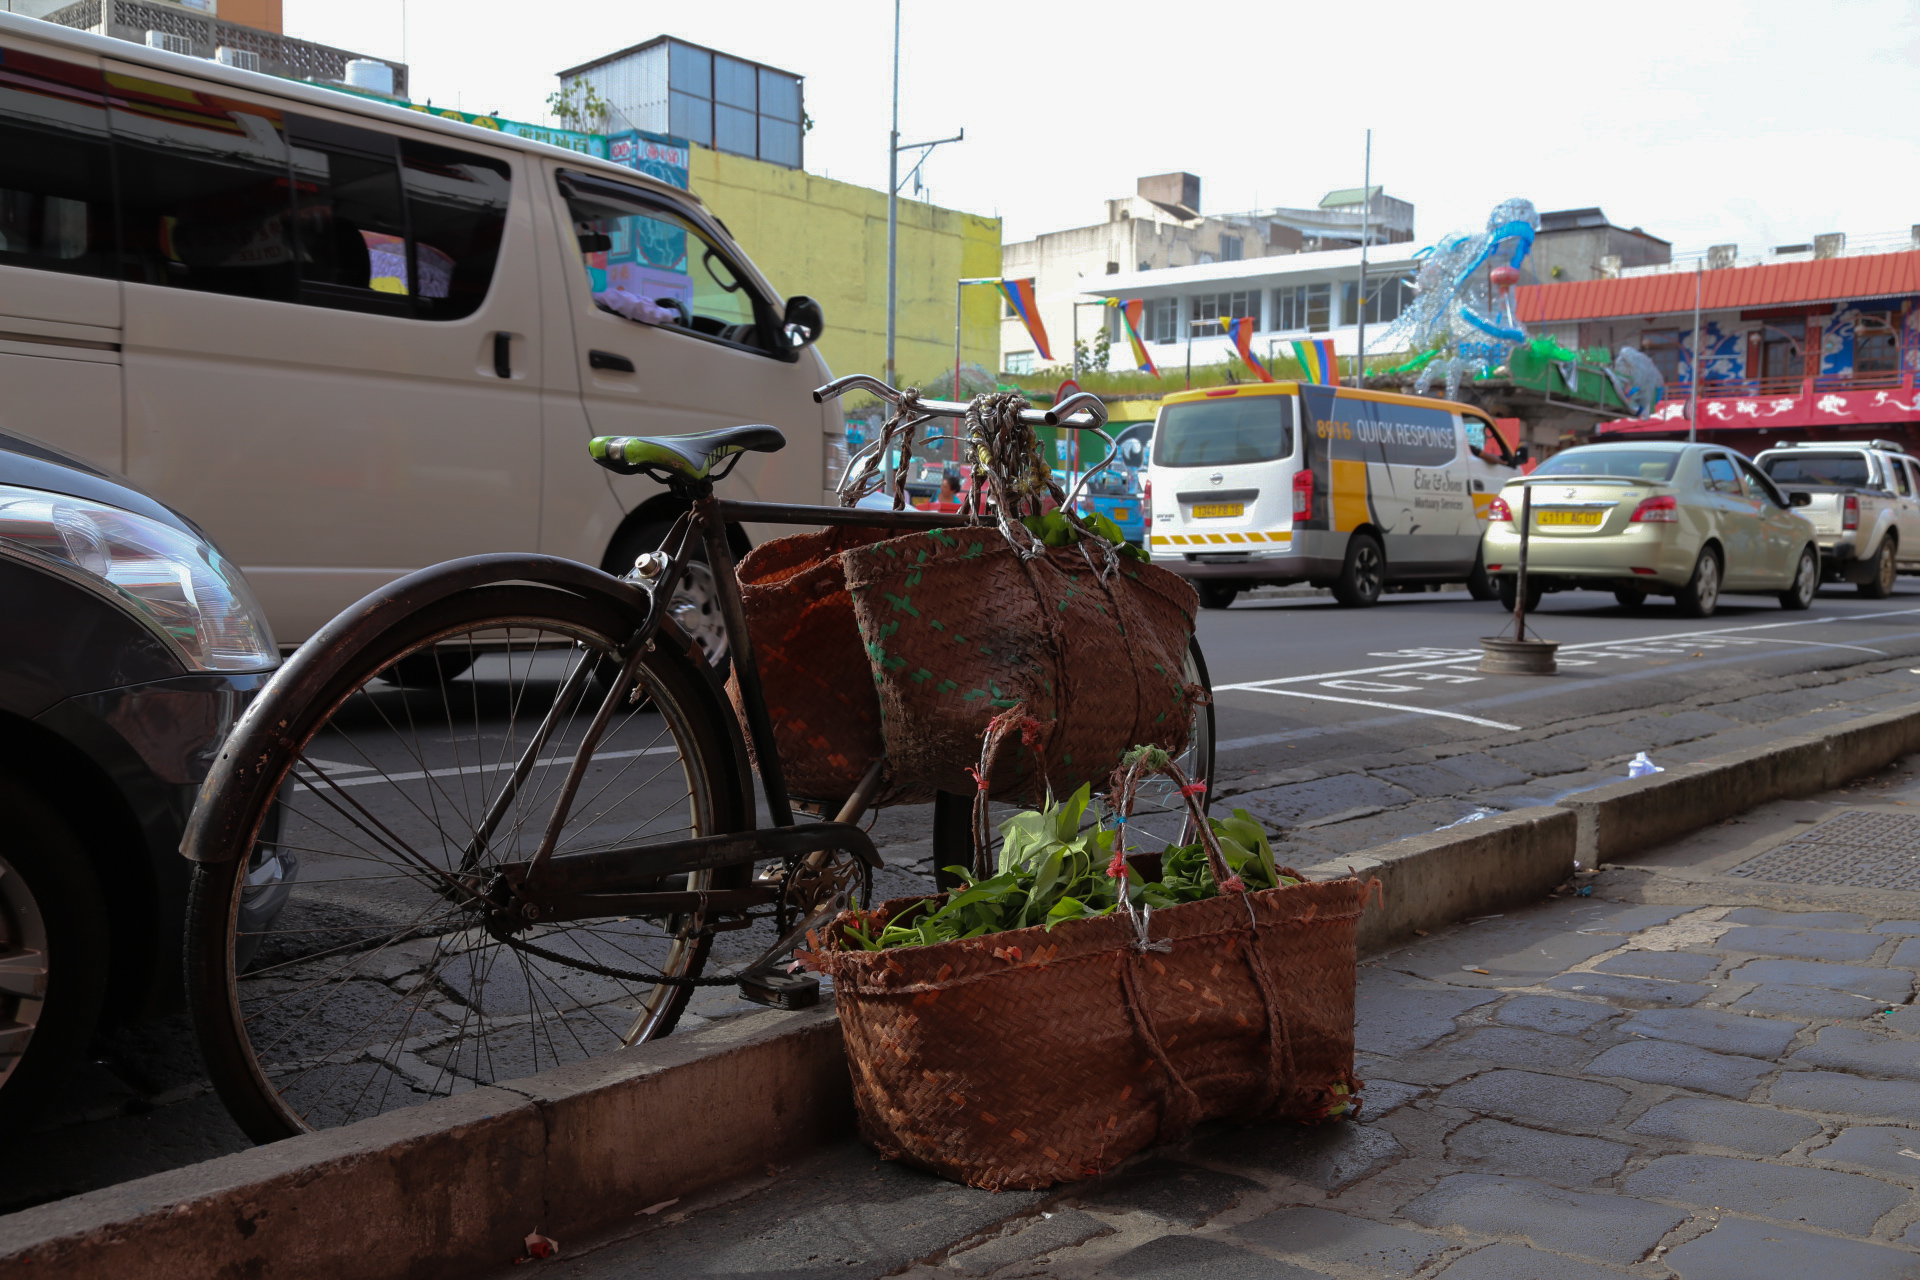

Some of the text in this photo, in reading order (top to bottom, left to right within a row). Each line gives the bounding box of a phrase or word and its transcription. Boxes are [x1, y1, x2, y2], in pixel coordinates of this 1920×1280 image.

[1316, 419, 1352, 440] 8916
[1356, 419, 1455, 449] QUICK RESPONSE
[1432, 473, 1442, 490] &
[1442, 469, 1462, 492] Sons
[1414, 497, 1463, 512] Mortuary Services
